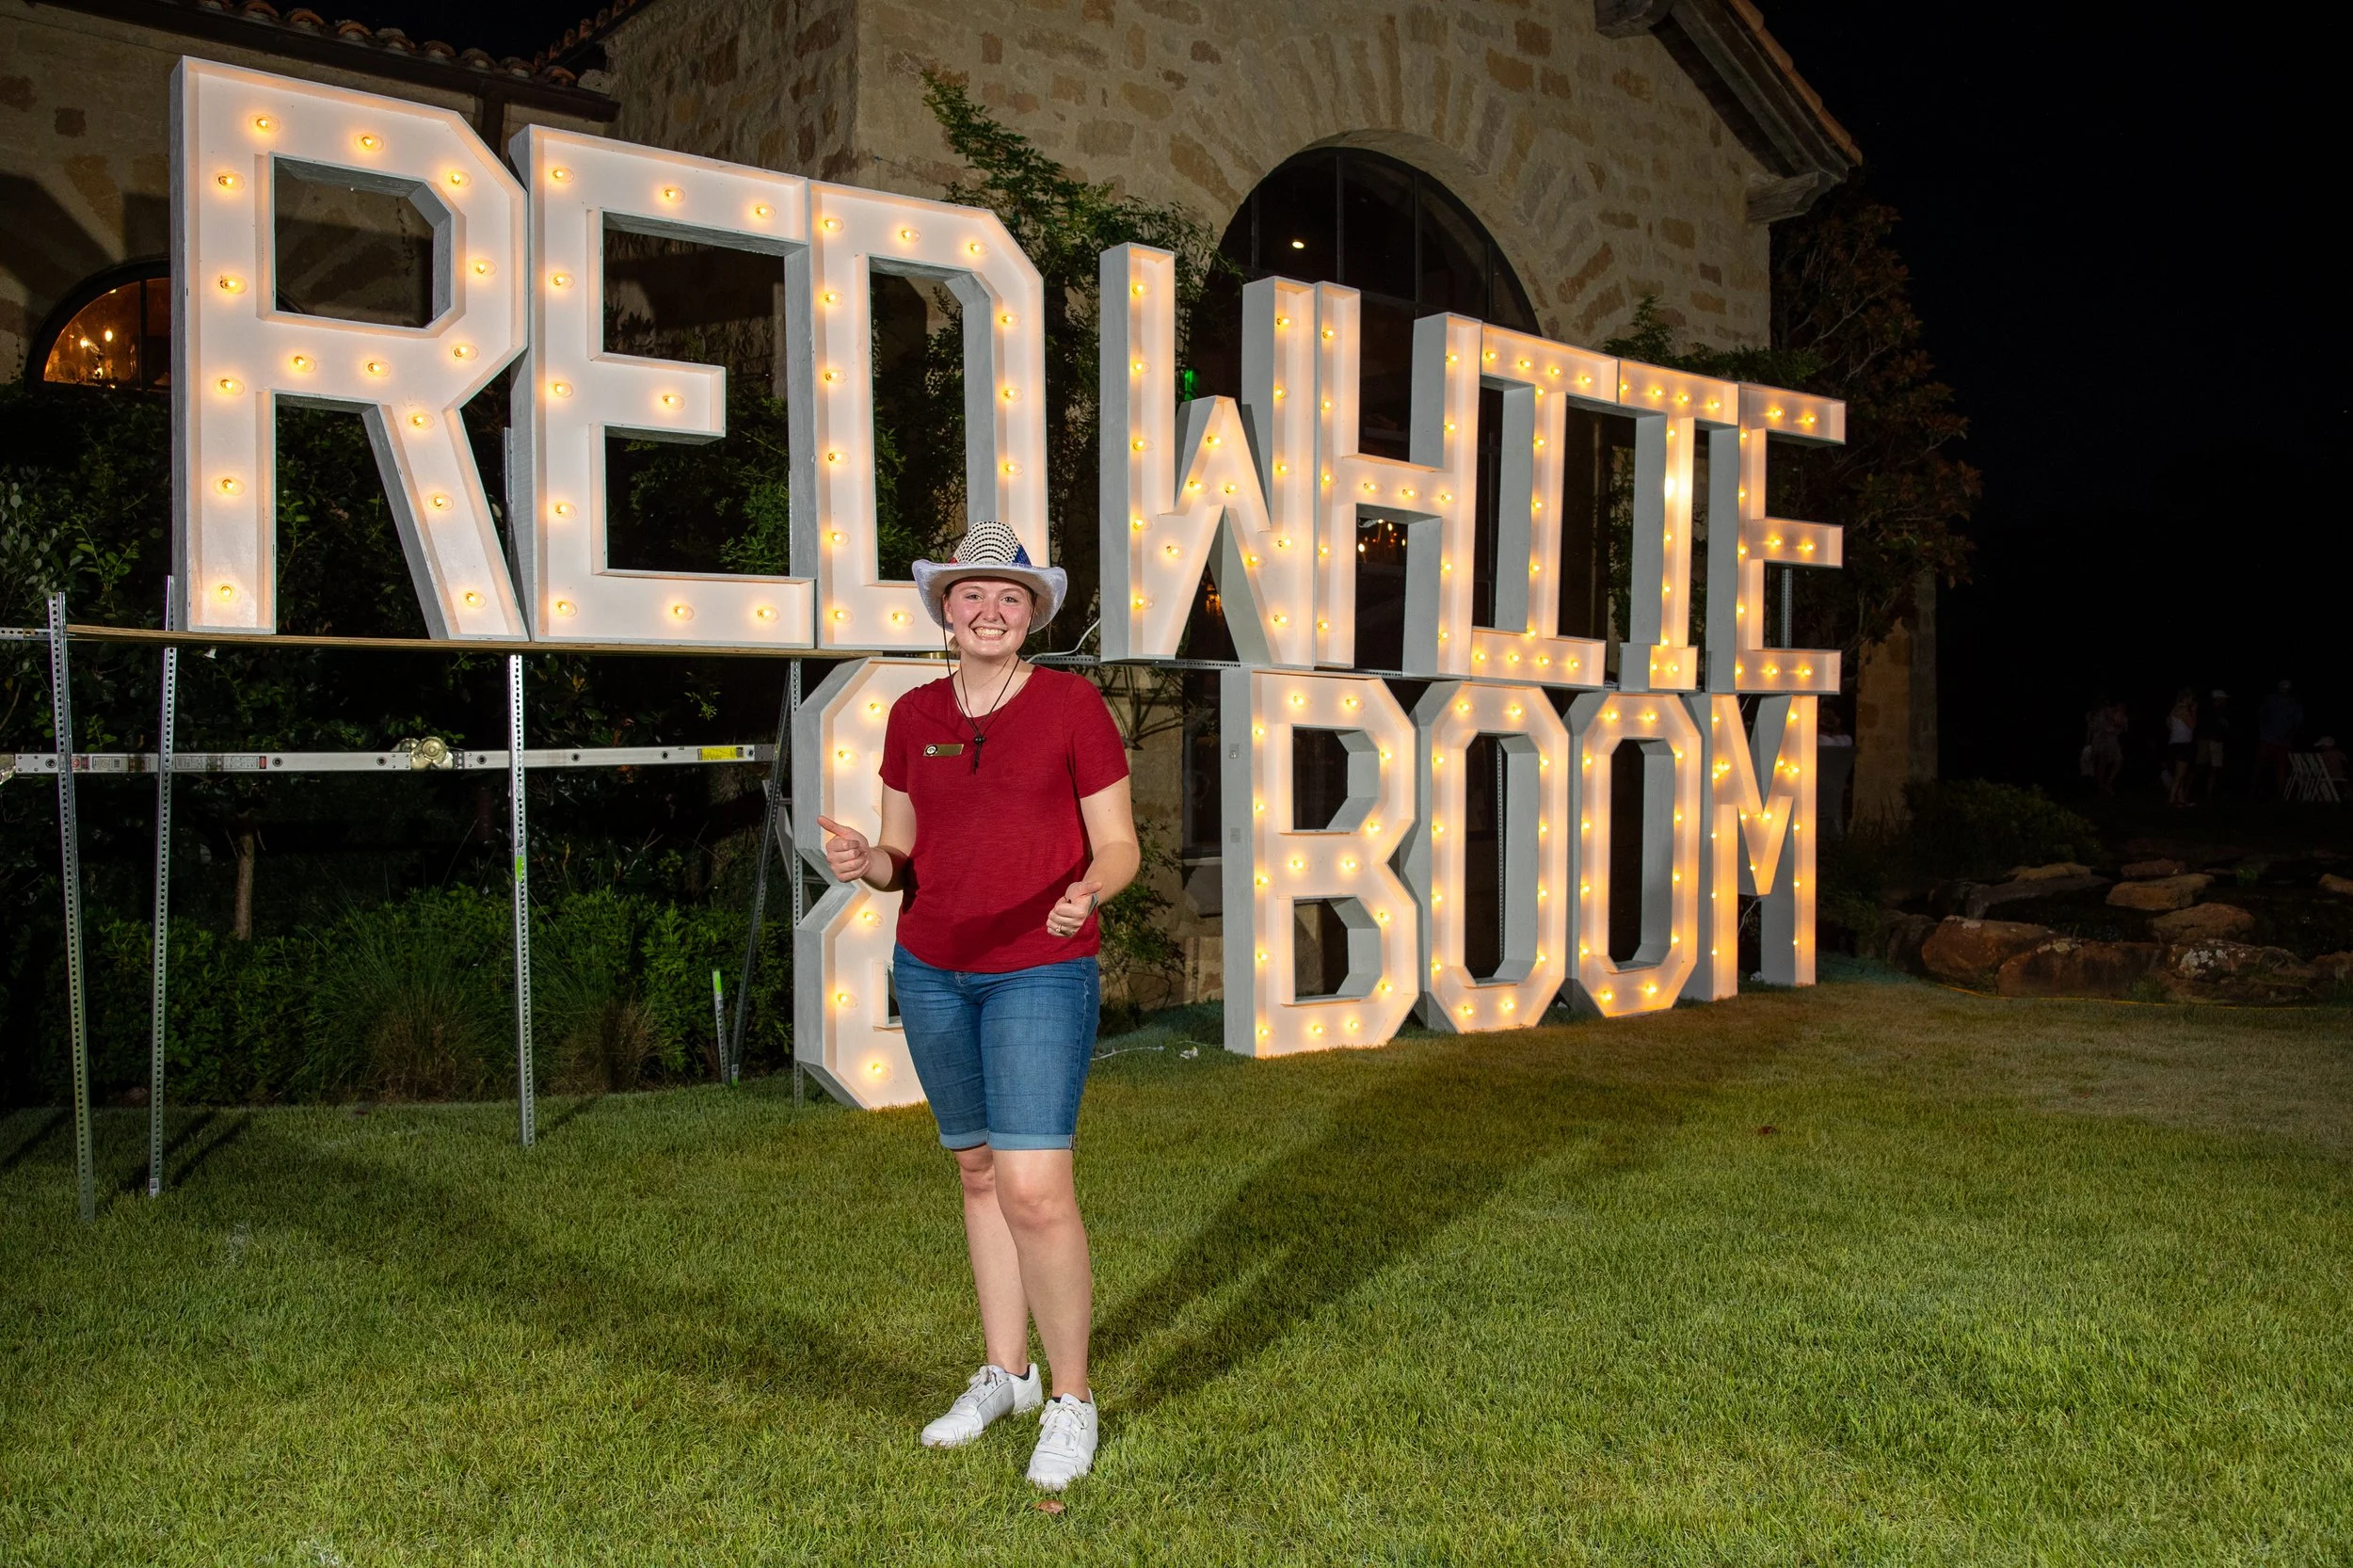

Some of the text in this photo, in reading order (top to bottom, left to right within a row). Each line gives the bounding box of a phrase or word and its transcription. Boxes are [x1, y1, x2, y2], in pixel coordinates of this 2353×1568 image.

[172, 56, 1846, 696] RED WHITE
[1223, 669, 1817, 1058] BOOM
